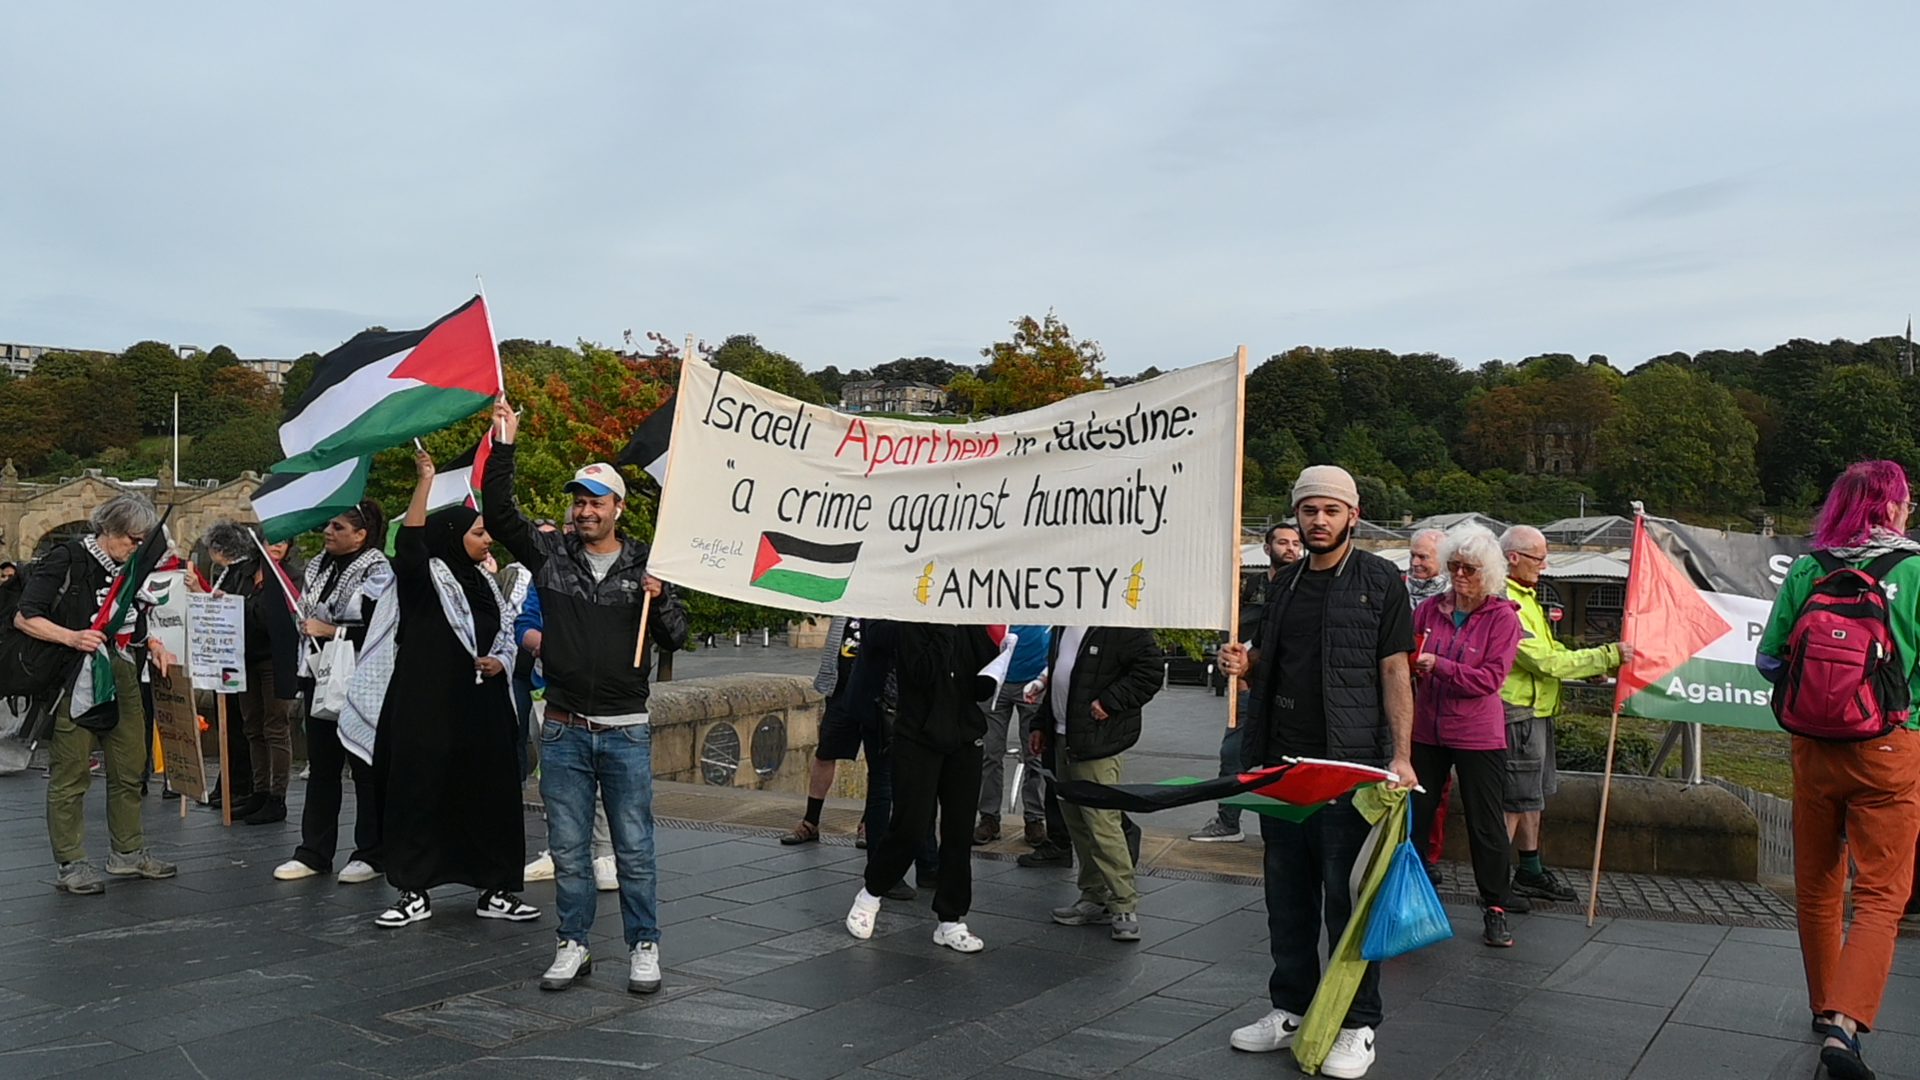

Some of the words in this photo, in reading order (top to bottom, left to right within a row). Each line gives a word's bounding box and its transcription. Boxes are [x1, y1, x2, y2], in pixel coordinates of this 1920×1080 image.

[702, 370, 812, 451] Israeli
[834, 418, 1000, 478] Apartheid
[777, 481, 873, 532] crime
[888, 478, 1010, 553] against
[691, 537, 743, 556] Sheffield
[700, 553, 726, 569] PSC
[937, 566, 1118, 611] AMNESTY
